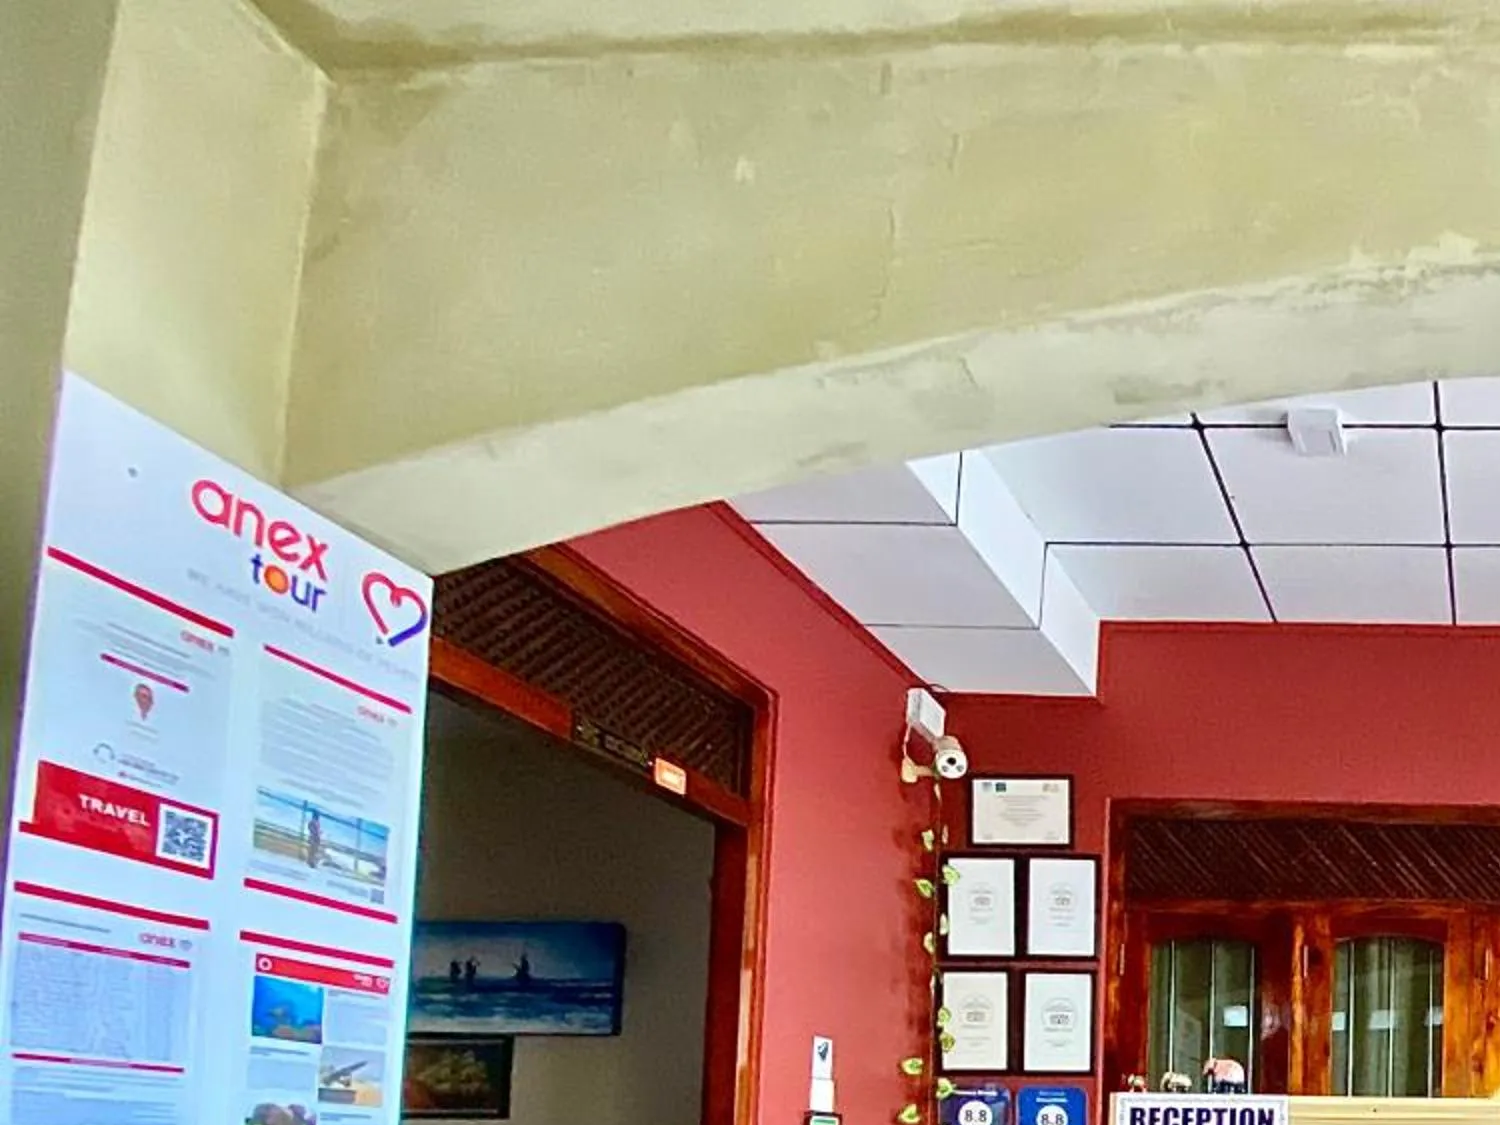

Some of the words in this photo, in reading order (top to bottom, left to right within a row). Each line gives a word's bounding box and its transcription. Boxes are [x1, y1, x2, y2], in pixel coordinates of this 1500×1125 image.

[191, 479, 328, 583] anex
[250, 553, 327, 612] tour
[78, 792, 151, 828] TRAVEL
[964, 1110, 987, 1122] 8.8
[1040, 1114, 1064, 1125] 8.8
